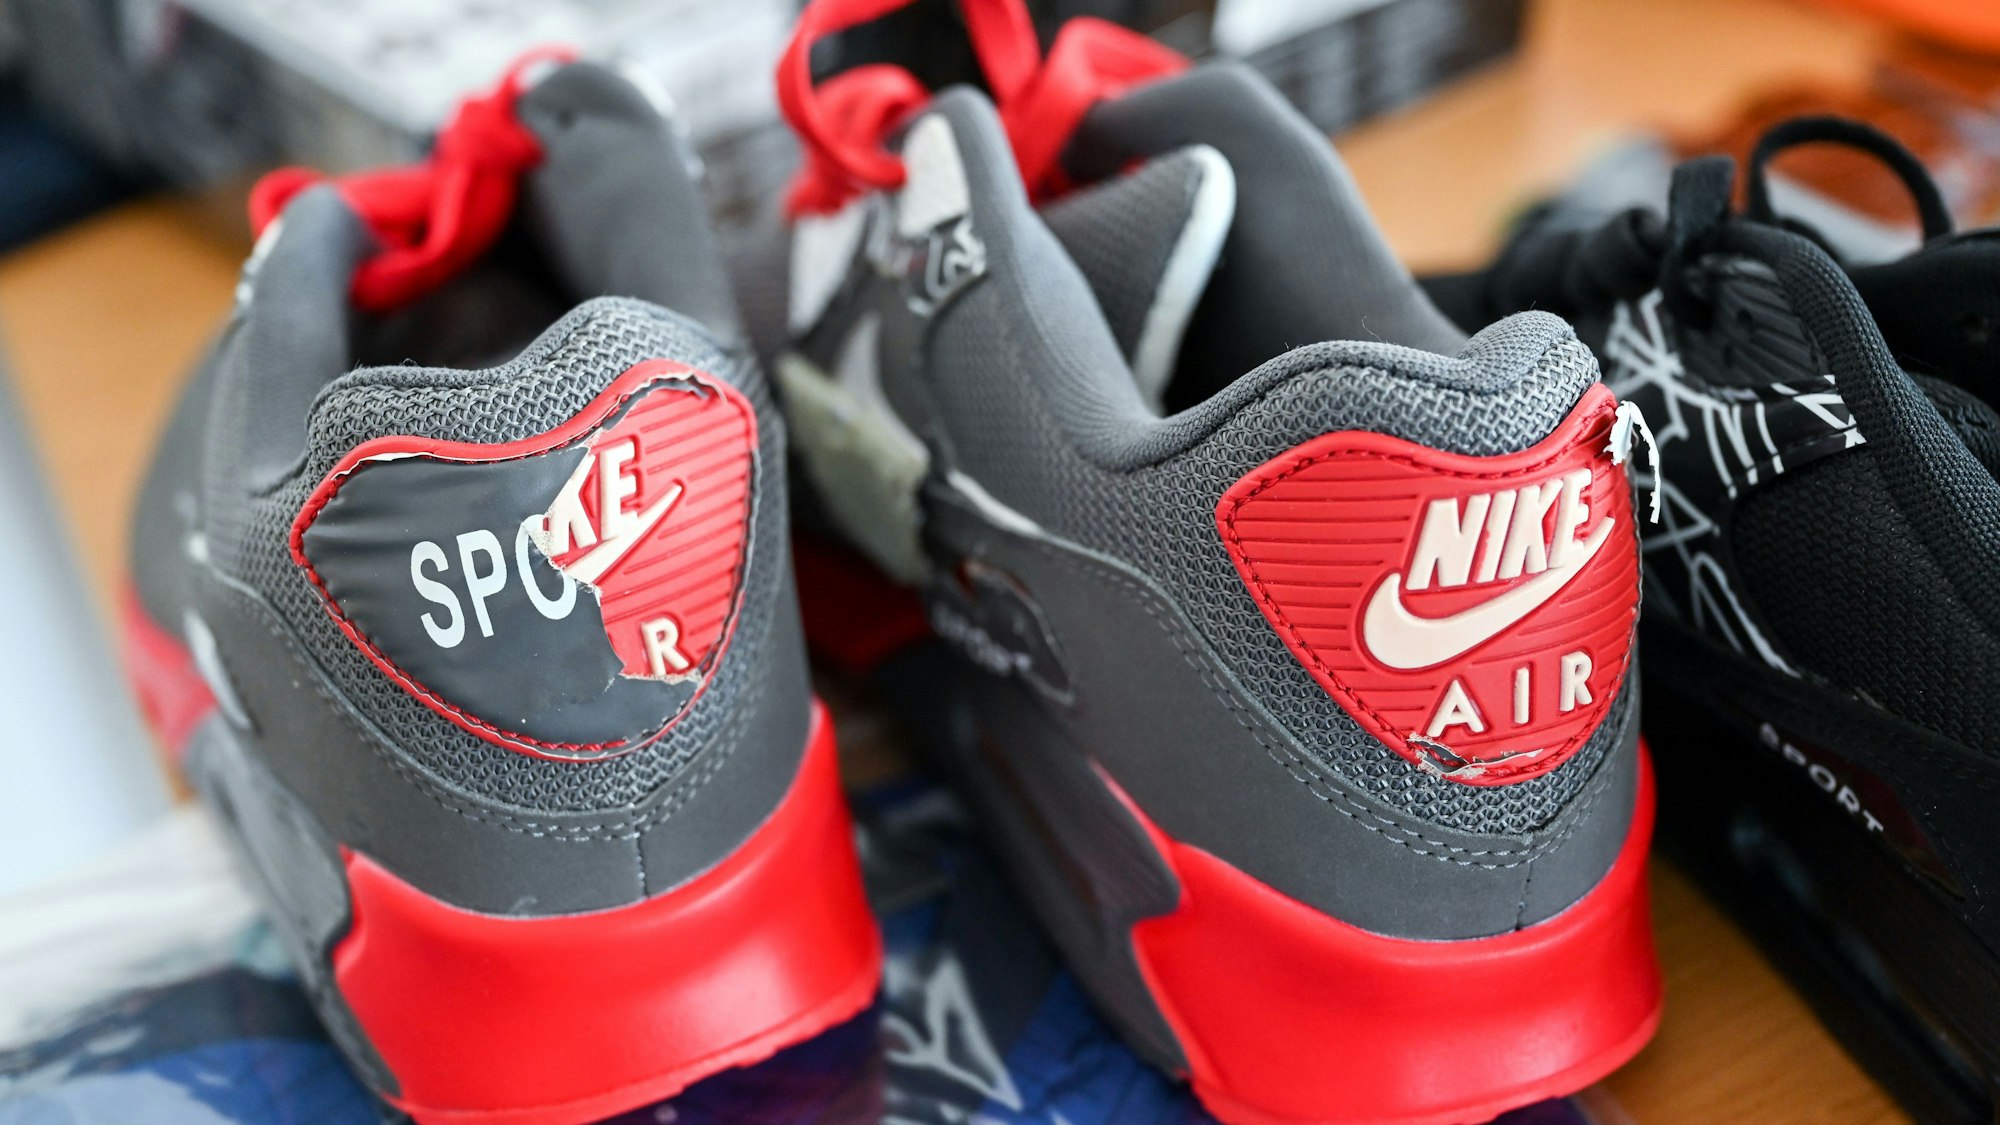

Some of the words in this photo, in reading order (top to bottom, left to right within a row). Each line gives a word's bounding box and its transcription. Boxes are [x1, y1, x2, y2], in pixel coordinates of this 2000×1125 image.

[1405, 468, 1592, 591] NIKE
[1426, 651, 1593, 737] AIR
[1760, 722, 1884, 832] SPORT
